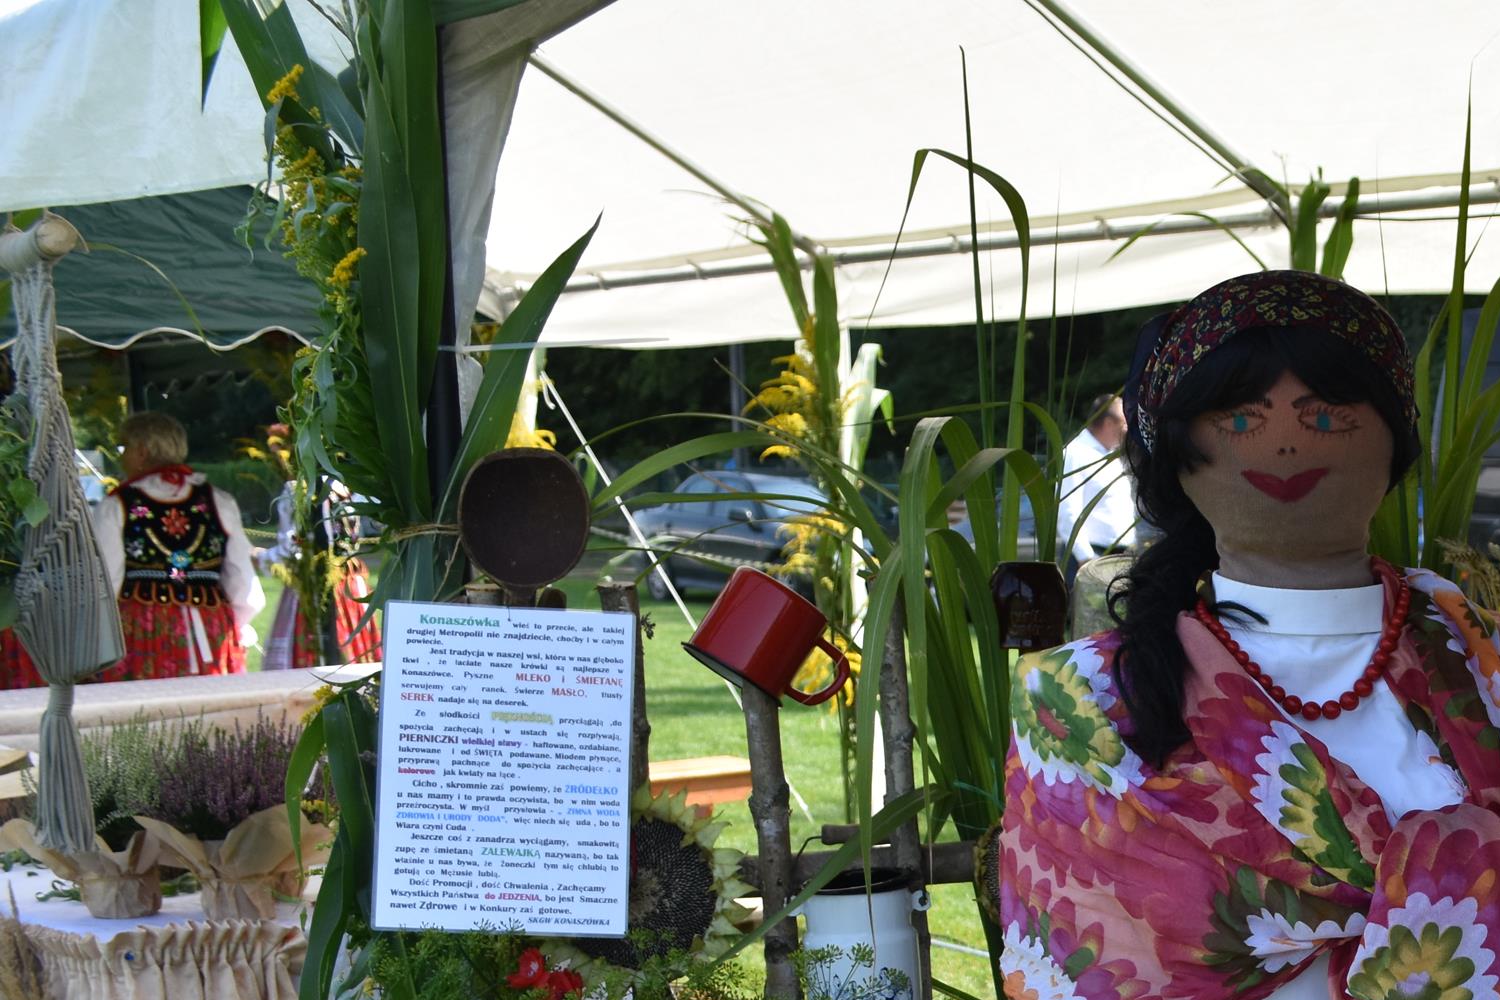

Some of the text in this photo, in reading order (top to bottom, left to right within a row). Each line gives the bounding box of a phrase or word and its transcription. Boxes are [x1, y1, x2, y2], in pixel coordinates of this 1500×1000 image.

[420, 614, 500, 627] Konaszówka
[546, 624, 578, 632] przecie,
[602, 627, 624, 635] takiej
[406, 628, 436, 637] drugiej
[438, 629, 484, 638] Metropolii
[502, 632, 554, 642] znajdziecie,
[556, 635, 584, 643] choćby
[600, 638, 624, 646] całym
[428, 647, 448, 655] Jest
[448, 648, 486, 658] tradycja
[496, 651, 524, 660] naszej
[592, 656, 624, 665] głęboko
[402, 656, 420, 664] tkwi
[520, 662, 548, 670] krówki
[572, 665, 610, 675] najlepsze
[402, 669, 622, 687] Konaszówce. Pyszne MLEKO ŚMIETANĘ
[400, 682, 444, 691] serwujemy
[400, 692, 434, 702] SEREK
[438, 696, 466, 705] nadaje
[468, 697, 480, 705] się
[494, 699, 528, 707] deserek.
[438, 710, 480, 719] słodkości
[558, 717, 604, 727] przyciągają
[398, 723, 434, 732] spożycia
[442, 725, 484, 734] zachęcają
[520, 729, 548, 737] ustach
[556, 730, 568, 739] się
[398, 733, 458, 744] PIERNICZKI
[462, 737, 496, 747] wielkiej
[498, 739, 522, 748] sławy
[398, 746, 442, 754] lukrowane
[474, 748, 504, 758] ŚWIĘTA
[554, 753, 586, 761] Miodem
[398, 757, 440, 766] przyprawą
[452, 759, 490, 768] pachnące
[516, 762, 552, 771] spożycia
[556, 763, 604, 773] zachęcające
[442, 768, 456, 777] jak
[458, 769, 484, 777] kwiaty
[412, 779, 438, 788] Cicho
[446, 781, 488, 790] skromnie
[510, 784, 550, 794] powiemy,
[426, 793, 454, 801] mamy
[476, 795, 506, 803] prawda
[508, 796, 550, 805] oczywista,
[472, 804, 490, 813] myśl
[504, 806, 546, 815] przysłowia
[596, 808, 620, 817] WODA
[396, 811, 436, 820] ZDROWIA
[512, 817, 532, 825] więc
[532, 817, 556, 825] niech
[558, 818, 570, 826] się
[396, 821, 466, 832] Wiara czyni Cuda
[410, 833, 444, 841] Jeszcze
[474, 835, 516, 844] zanadrza
[518, 837, 570, 847] wyciągamy,
[576, 840, 620, 848] smakowitą
[394, 846, 416, 854] zupę
[434, 847, 474, 856] śmietaną
[480, 847, 542, 859] ZALEWAJKĄ
[394, 867, 420, 876] gotują
[456, 859, 480, 867] bywa,
[544, 863, 558, 871] tym
[562, 863, 574, 871] się
[578, 863, 608, 872] chlubią
[408, 878, 606, 894] Dość Promocji dość Chwalenia Zachęcamy
[390, 889, 440, 898] Wszystkich
[442, 891, 480, 899] Państwa
[558, 895, 574, 904] jest
[578, 896, 618, 904] Smaczne
[418, 901, 458, 911] Zdrowe
[518, 905, 536, 913] zaś
[554, 917, 610, 926] KONASZÓWKA
